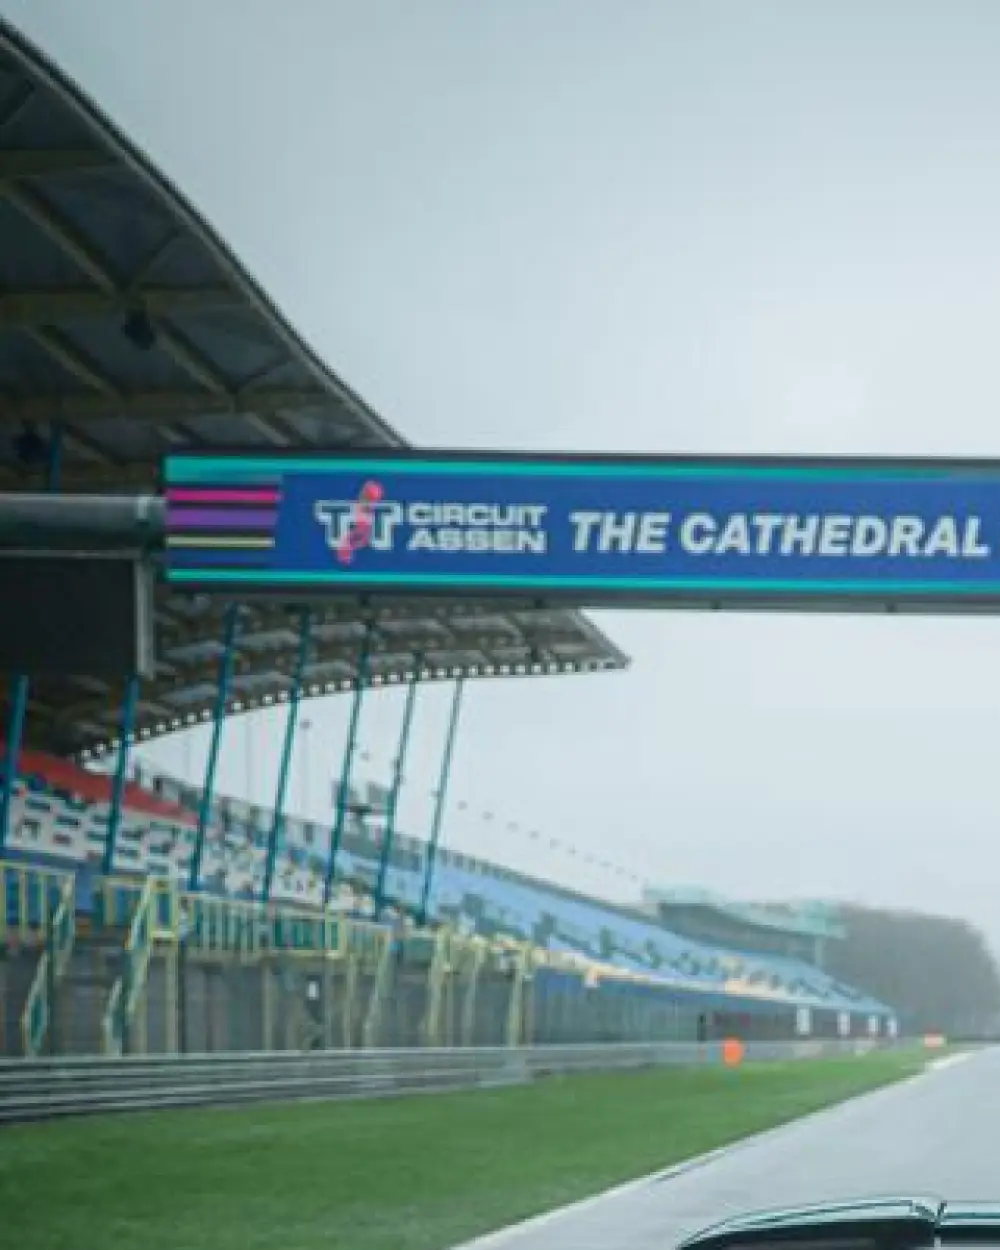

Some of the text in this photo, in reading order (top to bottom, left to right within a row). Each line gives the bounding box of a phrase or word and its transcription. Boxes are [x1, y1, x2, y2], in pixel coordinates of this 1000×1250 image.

[408, 503, 547, 526] CIRCUIT
[406, 528, 546, 553] ASSEN
[570, 512, 670, 554] THE
[680, 513, 989, 558] CATHEDRAL
